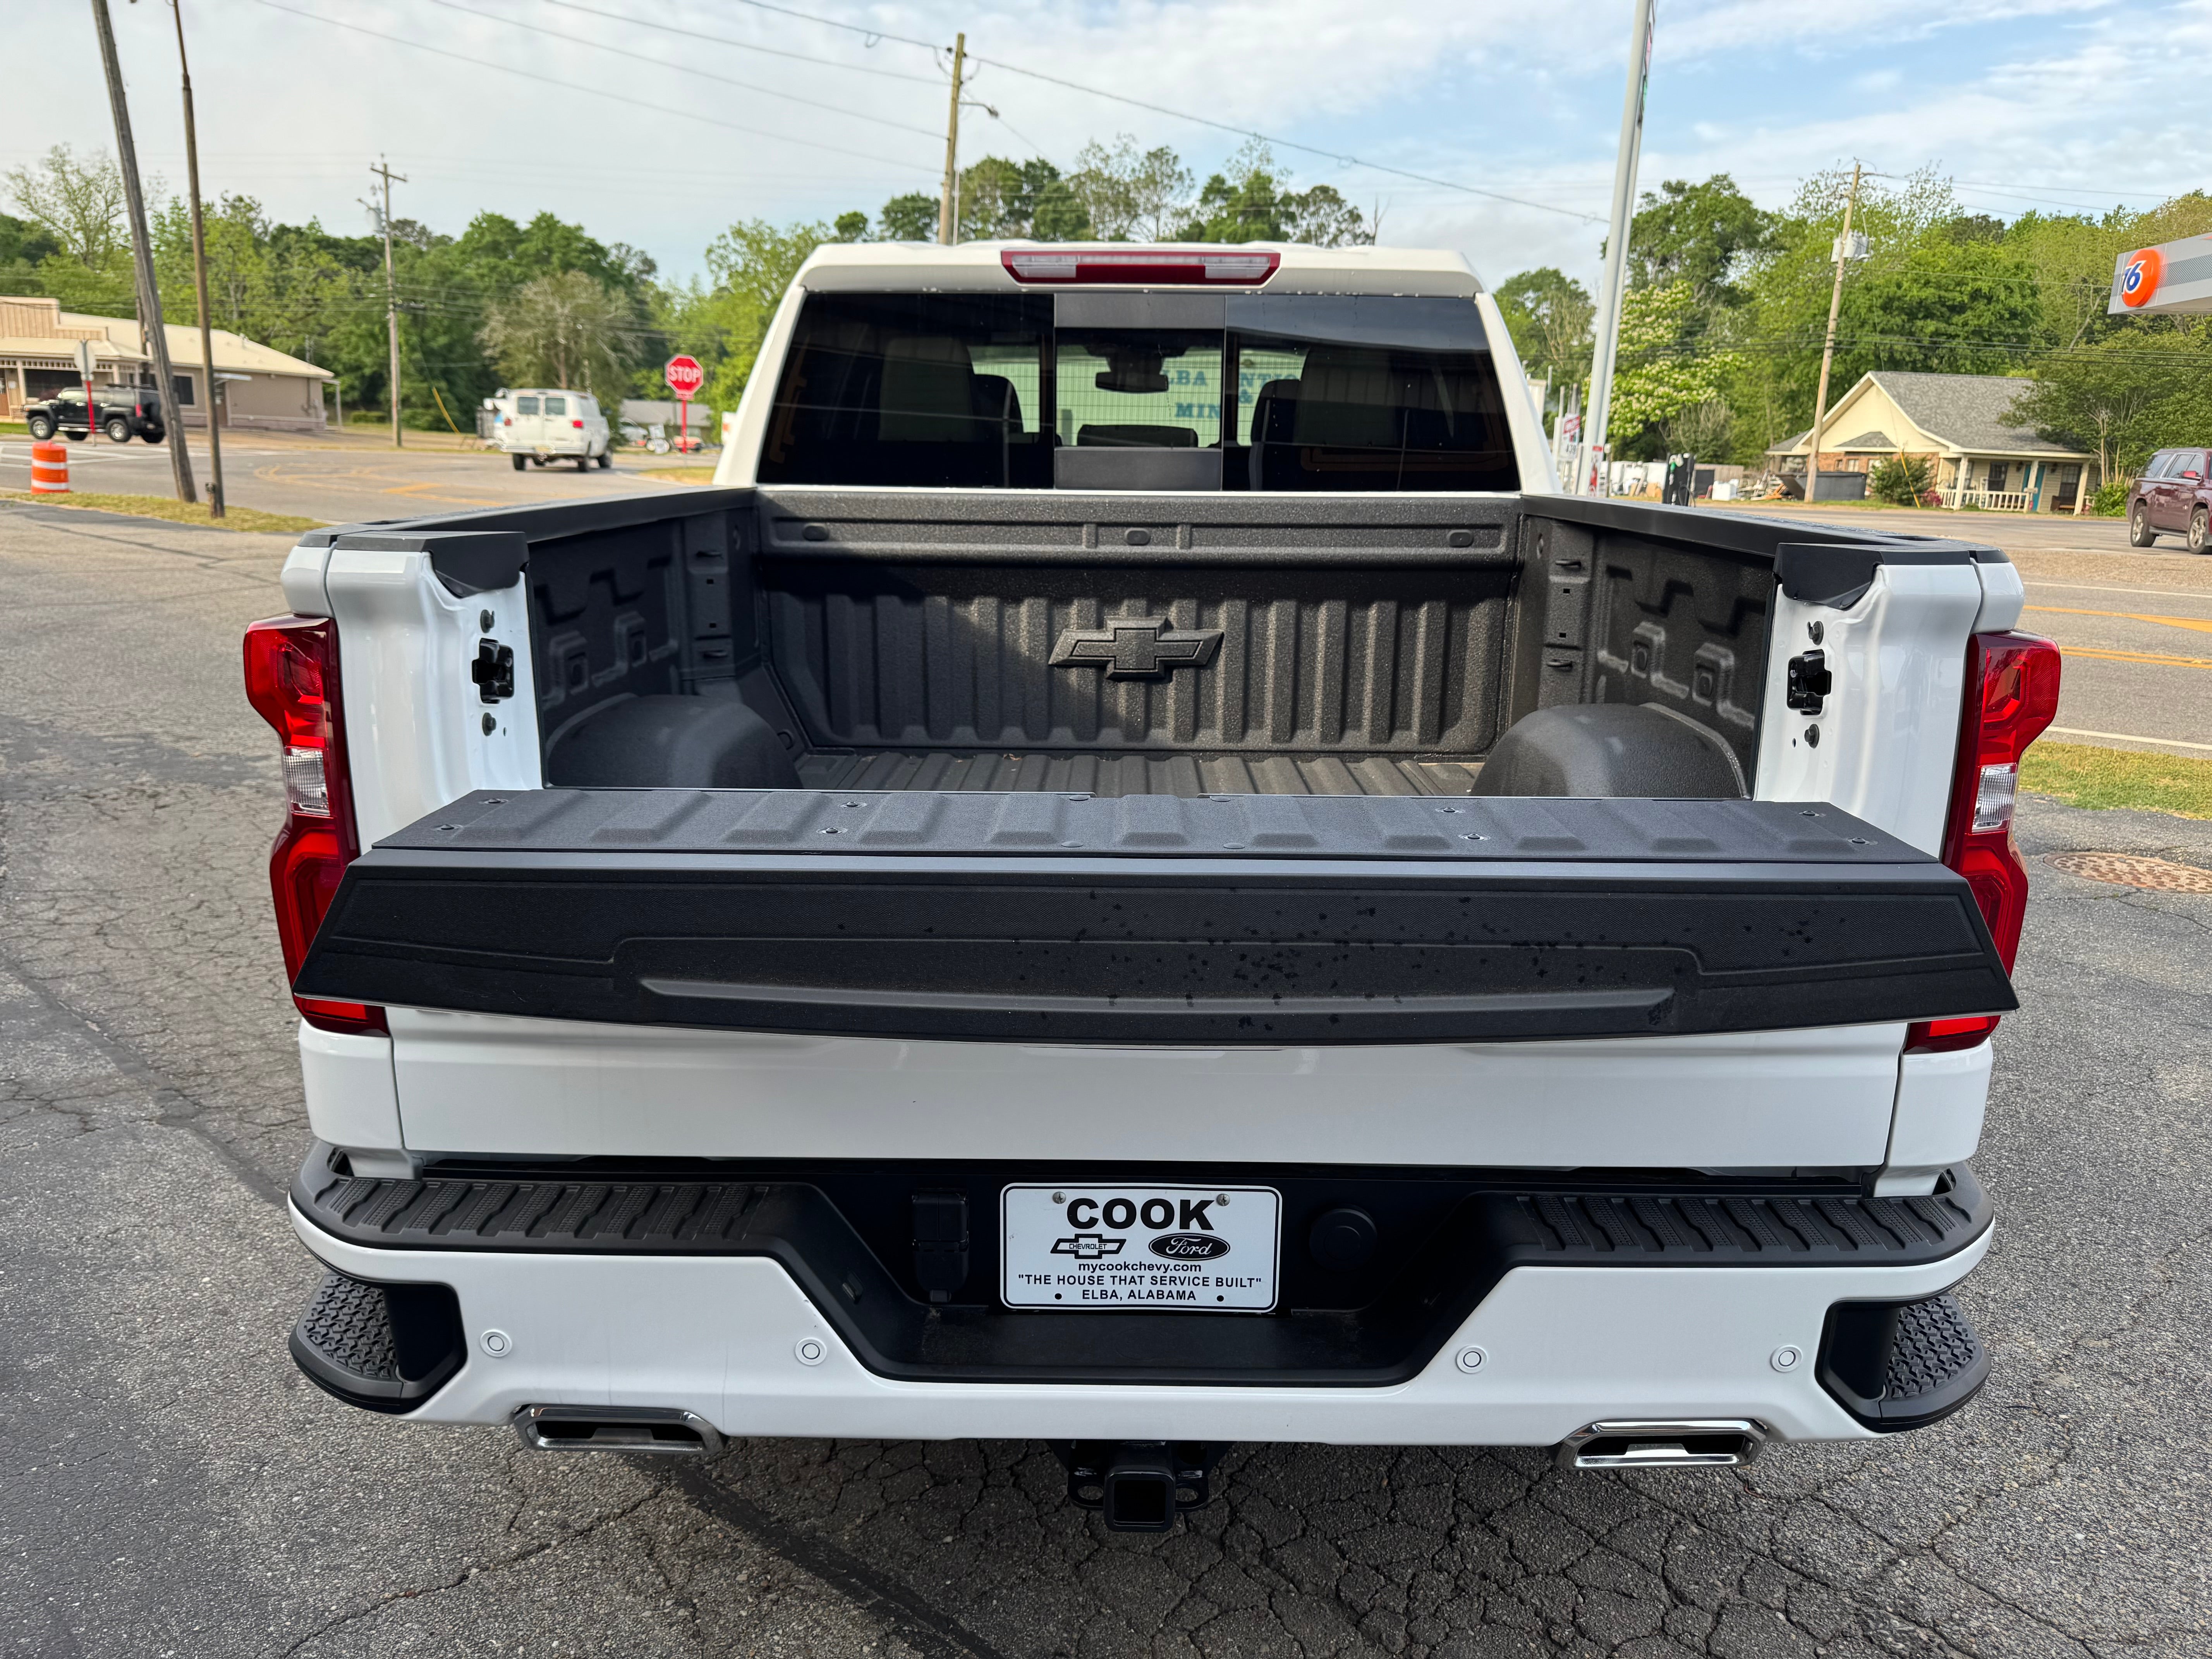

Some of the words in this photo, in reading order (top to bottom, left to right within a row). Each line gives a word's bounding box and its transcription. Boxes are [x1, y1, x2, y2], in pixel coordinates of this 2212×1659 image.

[2121, 260, 2147, 294] 76
[669, 365, 701, 383] STOP
[1067, 1198, 1214, 1230] COOK
[1166, 1237, 1212, 1255] Ford
[1079, 1261, 1201, 1273] mycookchevy.com
[1018, 1274, 1051, 1285] "THE
[1057, 1275, 1104, 1285] HOUSE
[1110, 1275, 1145, 1285] THAT
[1150, 1275, 1209, 1286] SERVICE
[1216, 1277, 1261, 1288] BUILT"
[1082, 1290, 1122, 1301] ELBA,
[1127, 1290, 1196, 1300] ALABAMA
